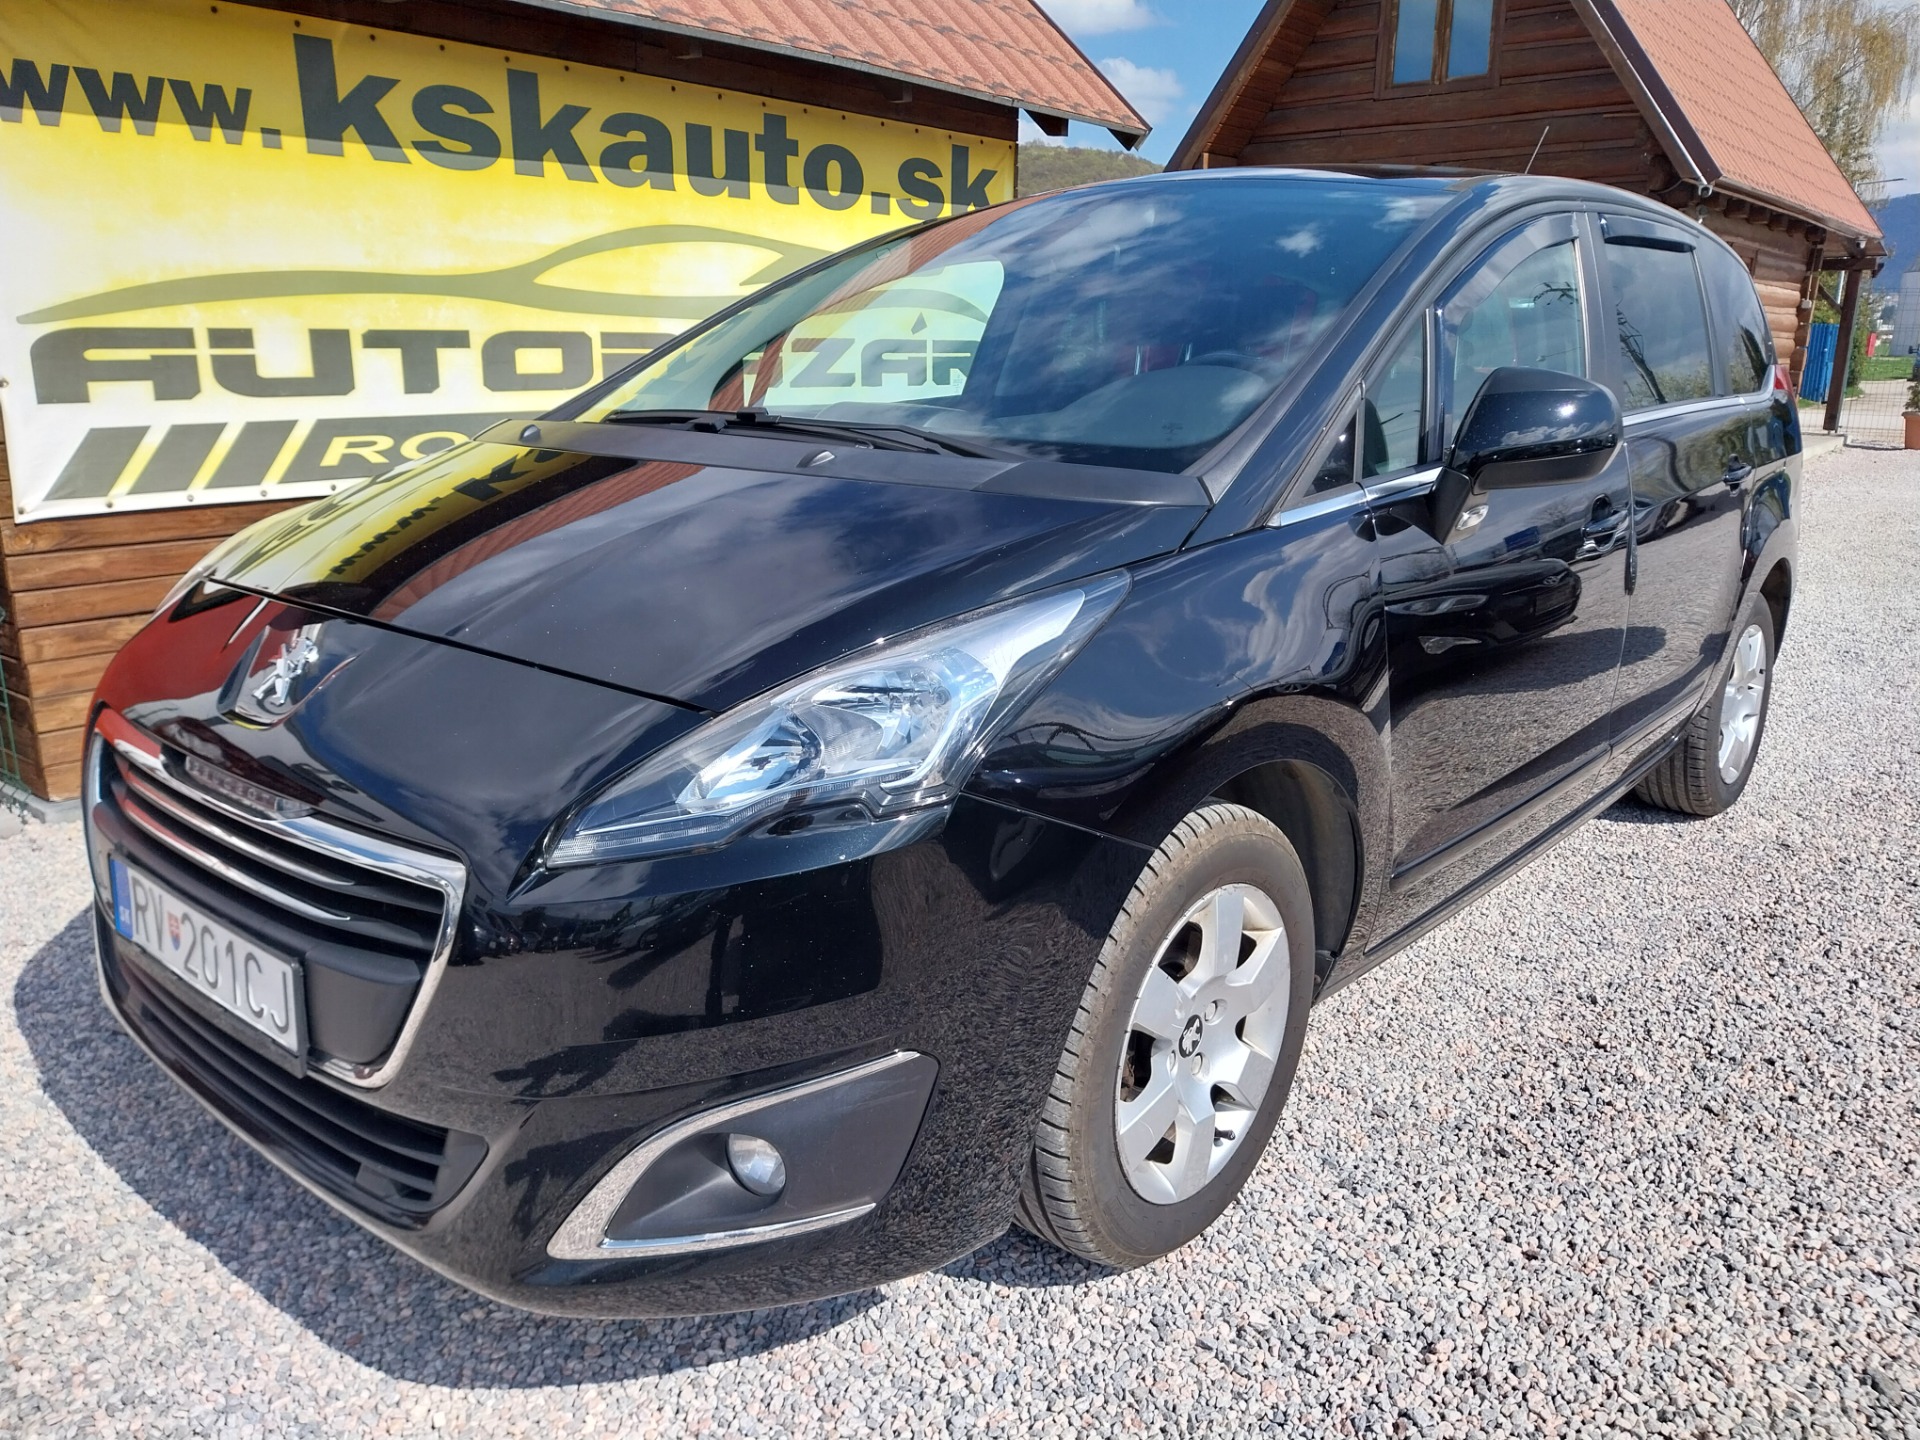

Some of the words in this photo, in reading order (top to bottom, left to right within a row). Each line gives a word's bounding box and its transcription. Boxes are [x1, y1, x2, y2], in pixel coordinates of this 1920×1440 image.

[0, 33, 998, 220] www.kskauto.sk
[131, 875, 164, 953] RV
[181, 911, 290, 1035] 201CJ
